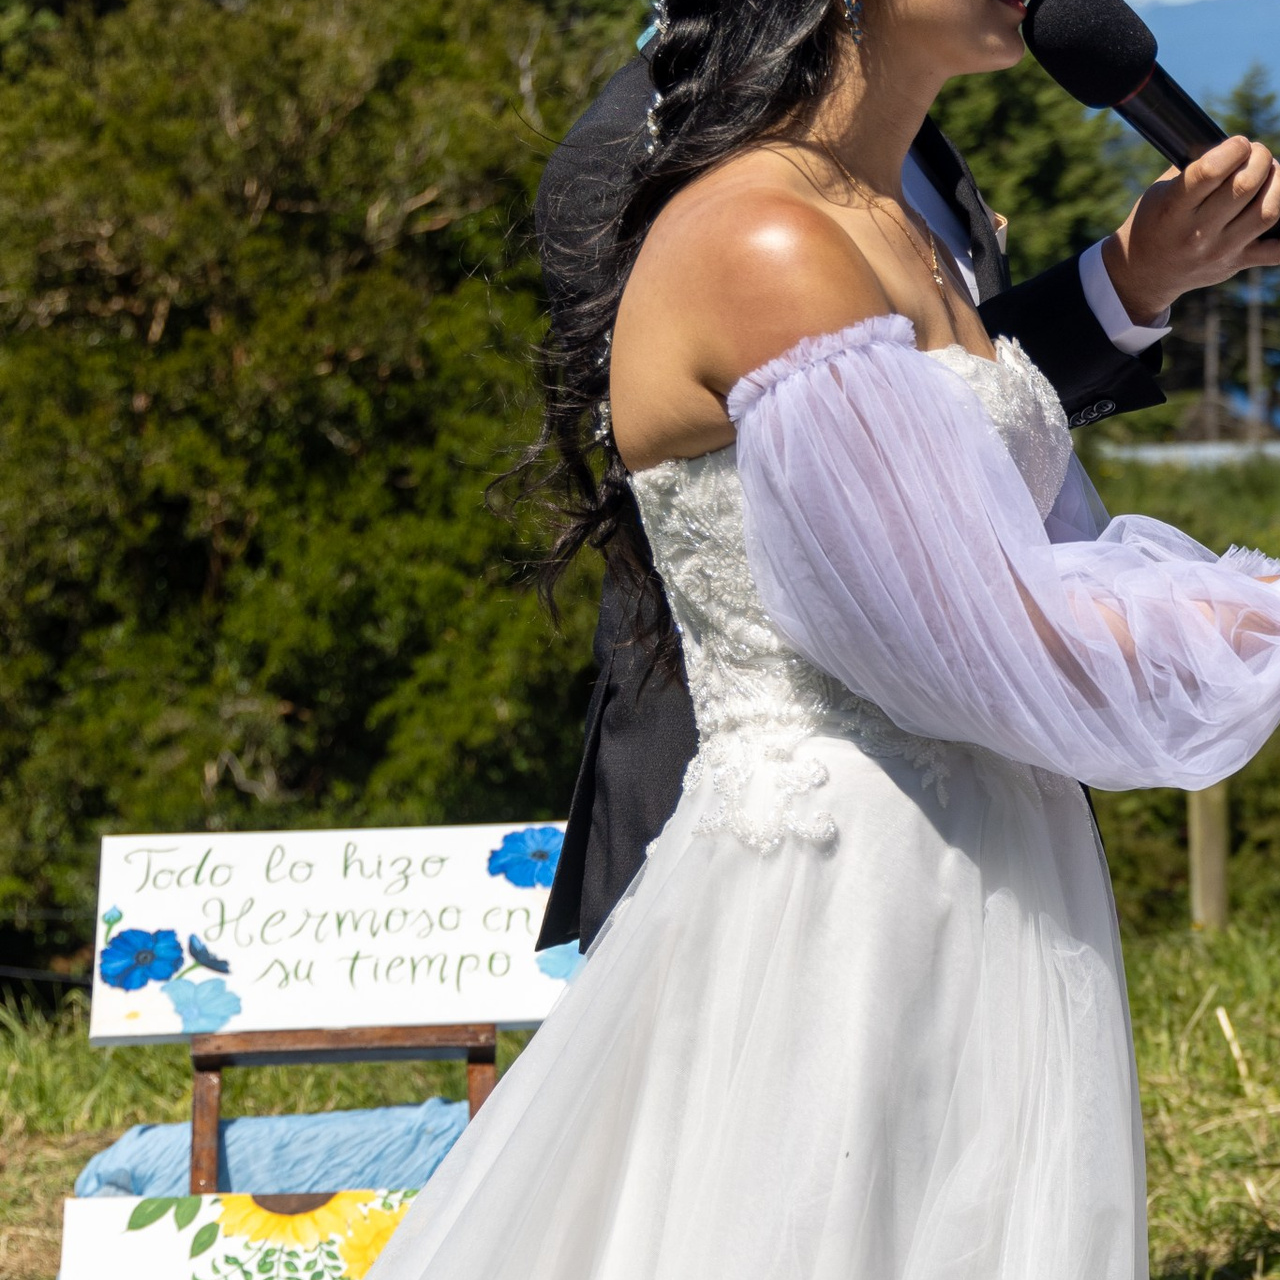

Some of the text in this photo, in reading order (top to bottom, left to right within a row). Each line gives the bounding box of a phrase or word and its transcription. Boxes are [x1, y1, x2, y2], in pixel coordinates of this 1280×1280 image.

[124, 841, 449, 895] Todo lo hizo
[201, 897, 535, 946] Hermoso en
[255, 950, 511, 993] su tiempo
